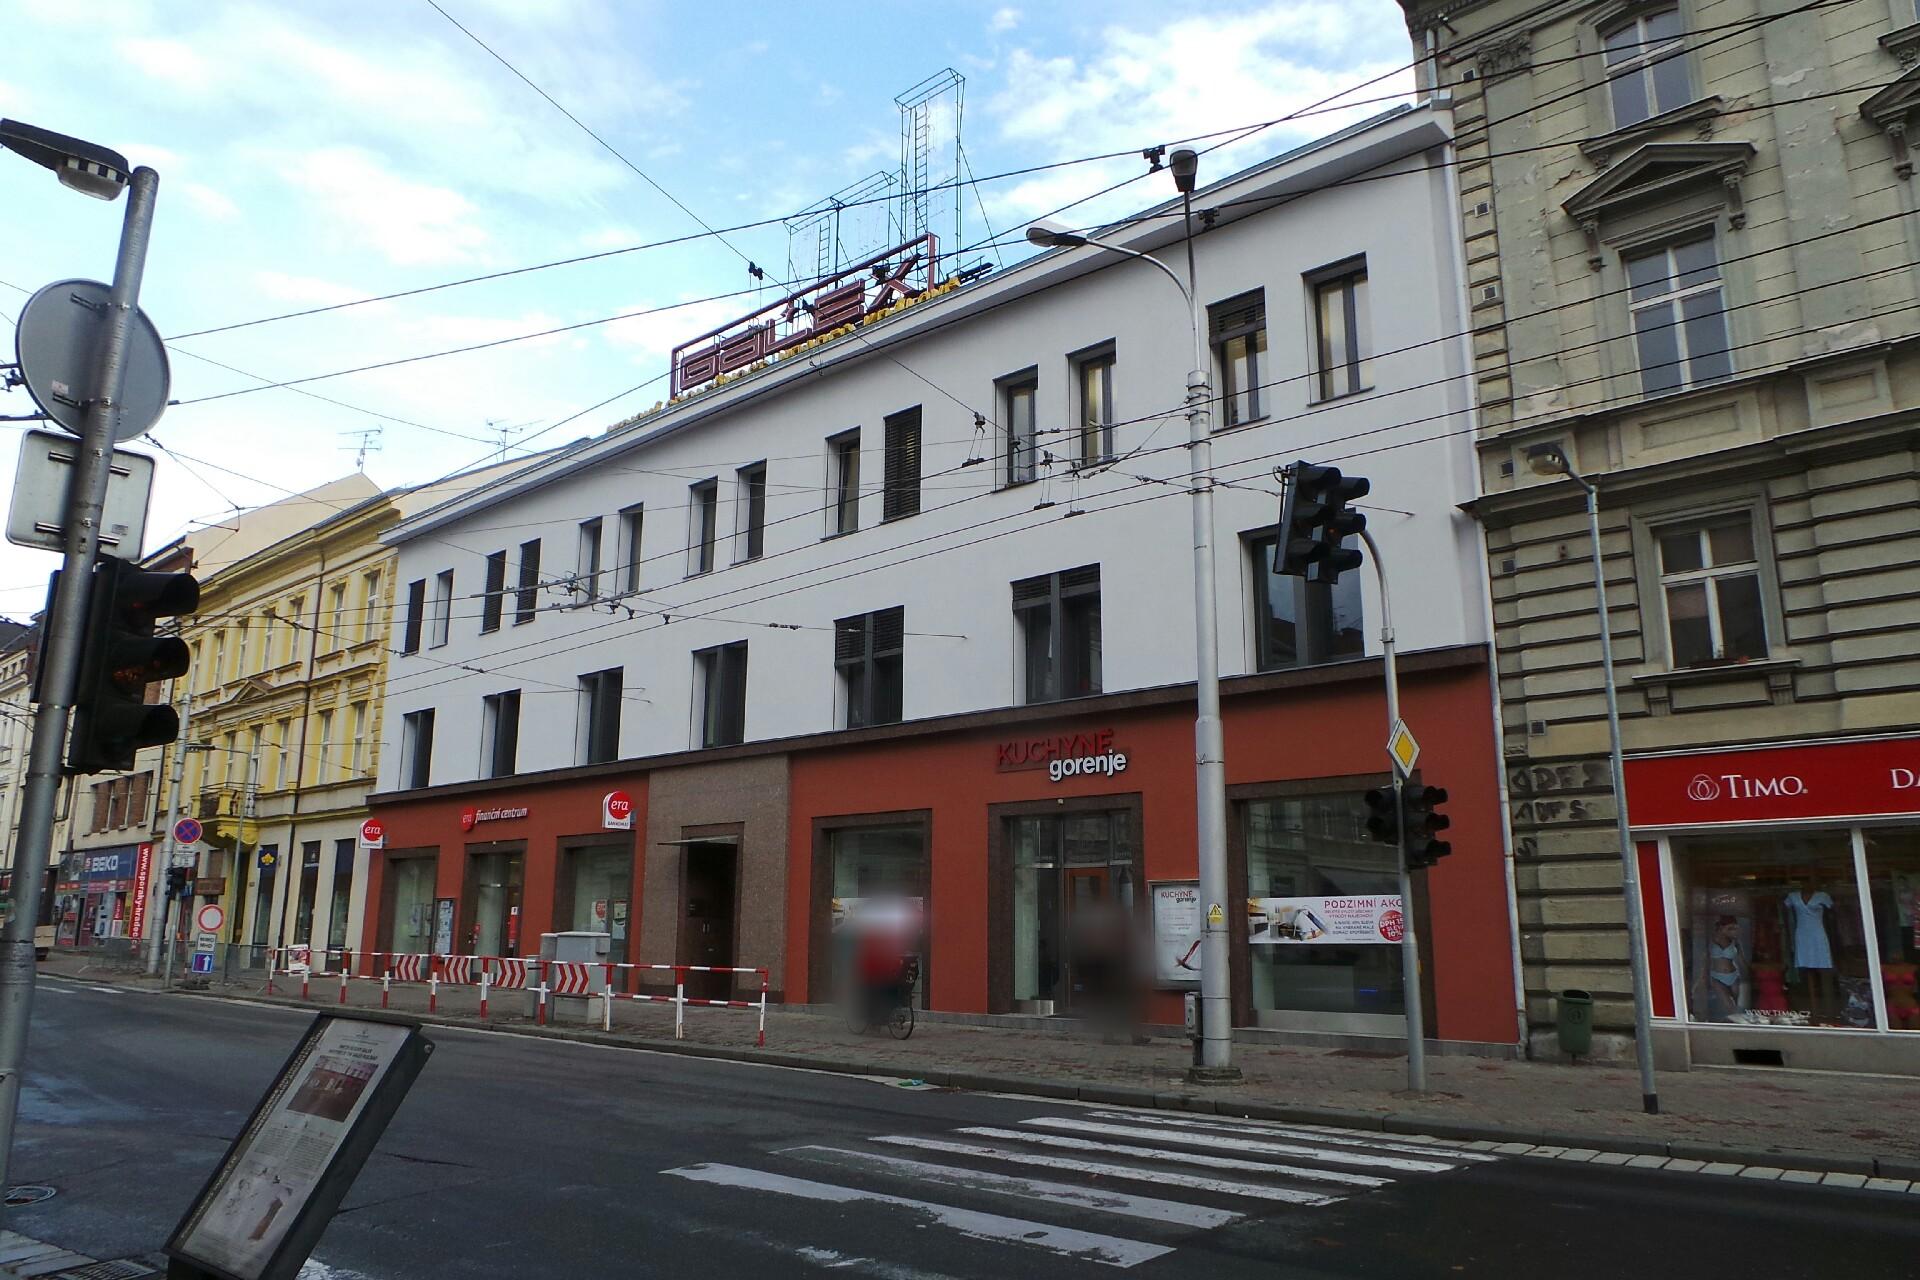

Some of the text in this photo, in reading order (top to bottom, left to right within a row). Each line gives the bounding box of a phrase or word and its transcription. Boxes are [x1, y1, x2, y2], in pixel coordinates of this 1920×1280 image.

[1049, 749, 1127, 782] gorenje
[611, 800, 629, 811] era
[462, 807, 528, 824] era finanční centrum
[364, 826, 381, 836] era
[91, 855, 119, 872] BEKO
[1324, 898, 1403, 908] PODZIMNÍ AKC
[1380, 919, 1396, 928] DPH
